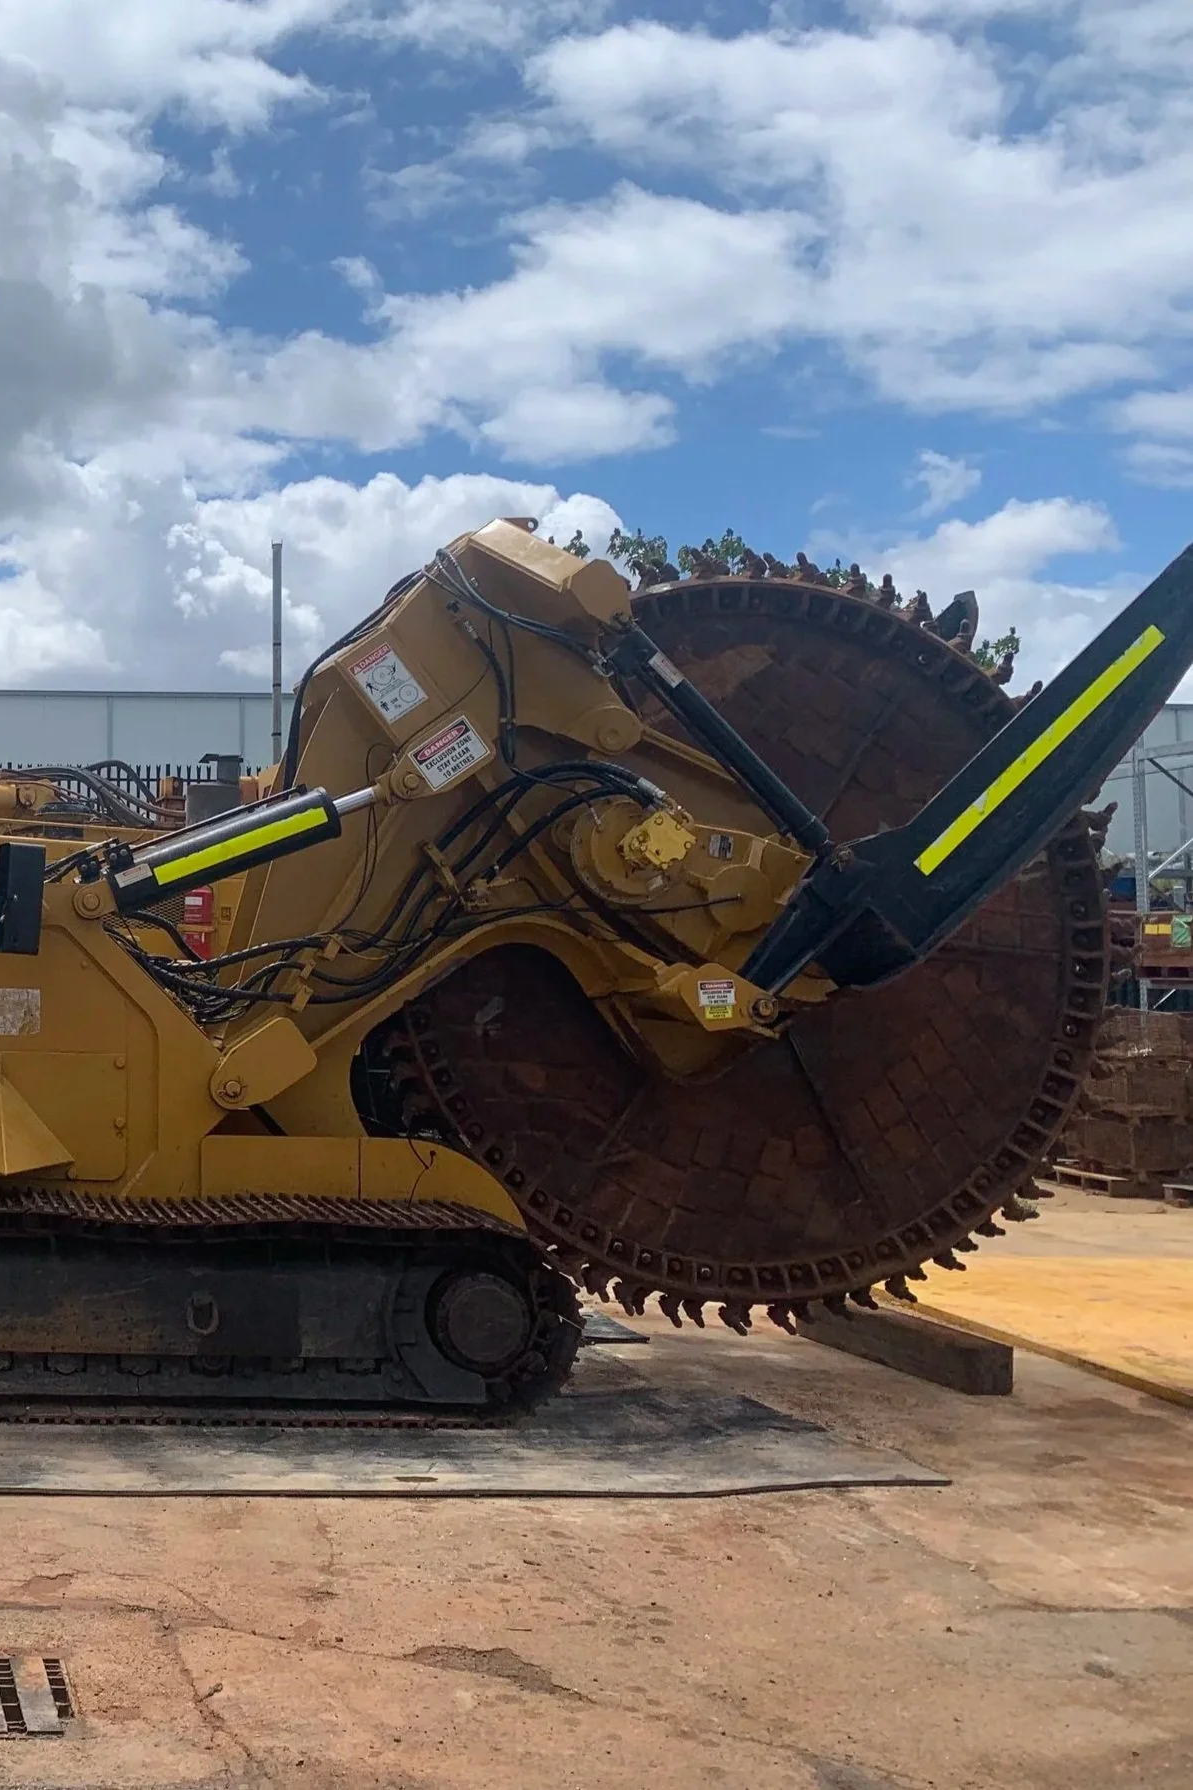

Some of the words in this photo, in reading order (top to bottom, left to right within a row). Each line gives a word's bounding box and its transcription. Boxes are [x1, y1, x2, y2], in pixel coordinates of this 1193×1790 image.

[358, 645, 391, 669] DANGER
[423, 729, 459, 757] DANGER
[425, 746, 457, 770] EXCLUSION
[456, 735, 473, 749] ZONE
[436, 759, 452, 772] STAY
[451, 746, 471, 764] CLEAR
[442, 769, 452, 779] 10
[451, 754, 475, 772] METRES
